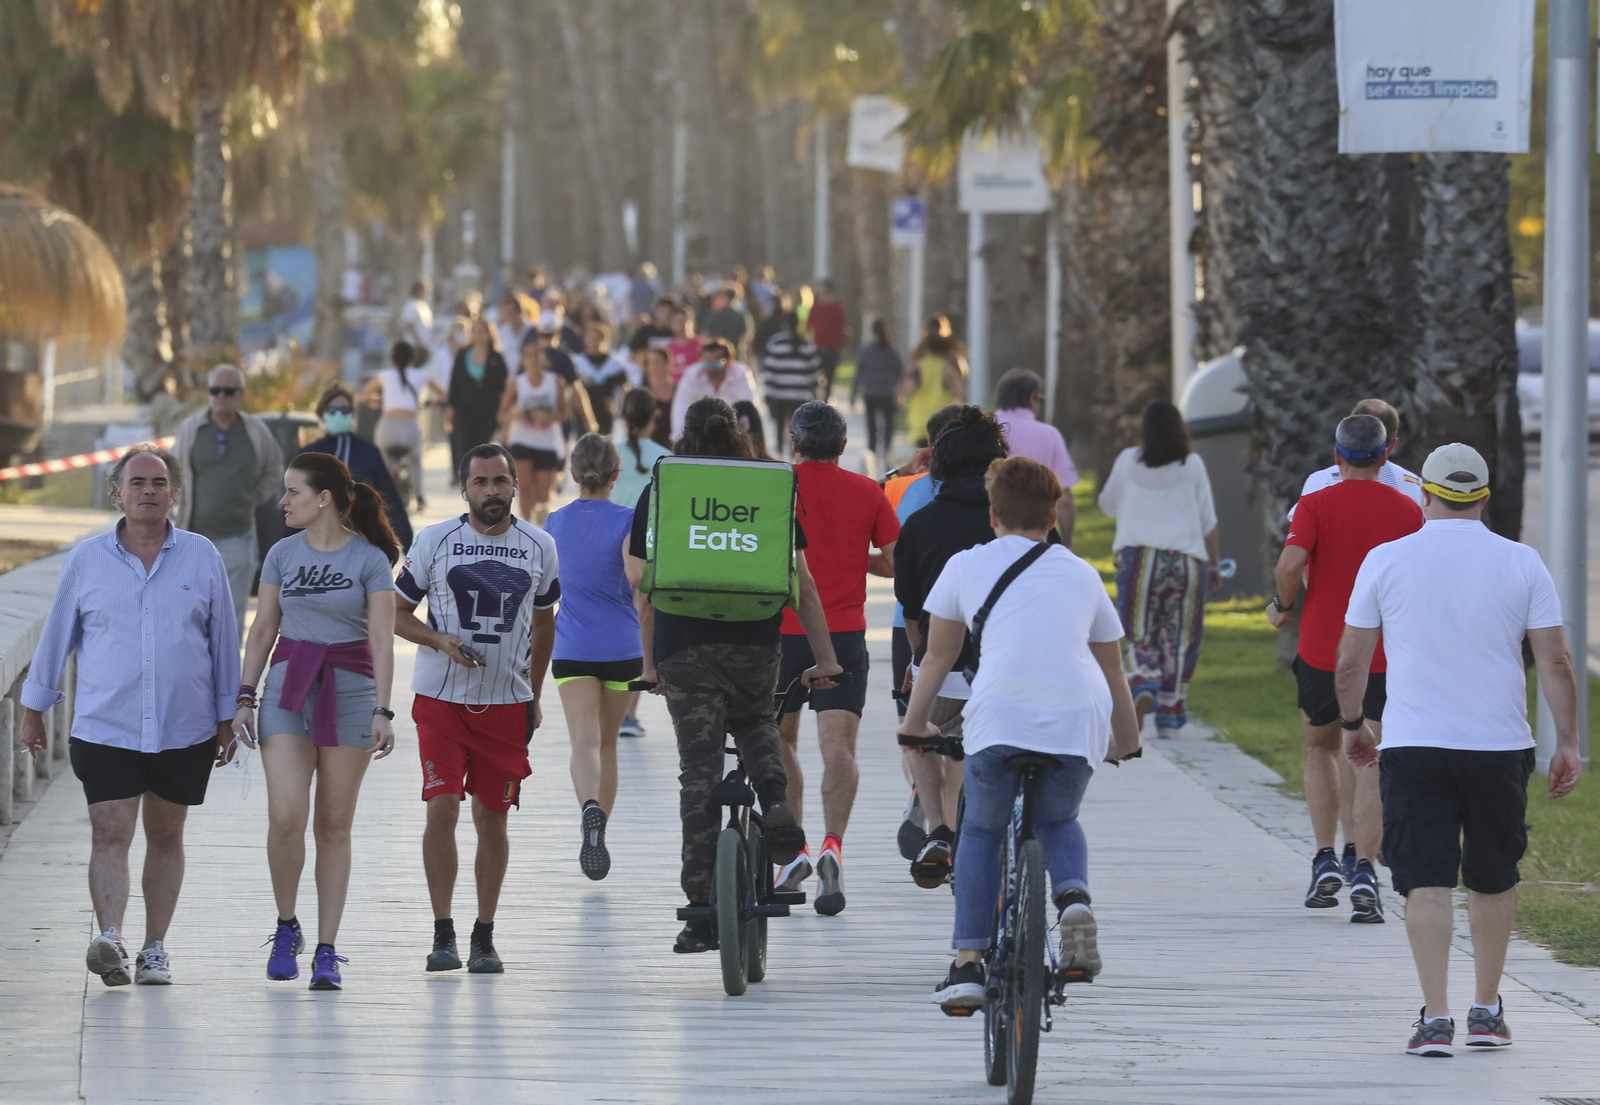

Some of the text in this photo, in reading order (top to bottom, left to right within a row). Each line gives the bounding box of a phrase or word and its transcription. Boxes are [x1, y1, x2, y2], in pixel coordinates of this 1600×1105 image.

[1366, 64, 1432, 81] hay que
[1367, 82, 1496, 98] ser más limpios
[691, 497, 760, 523] Uber
[689, 525, 759, 552] Eats
[453, 543, 528, 560] Banamex
[283, 564, 353, 590] Nike
